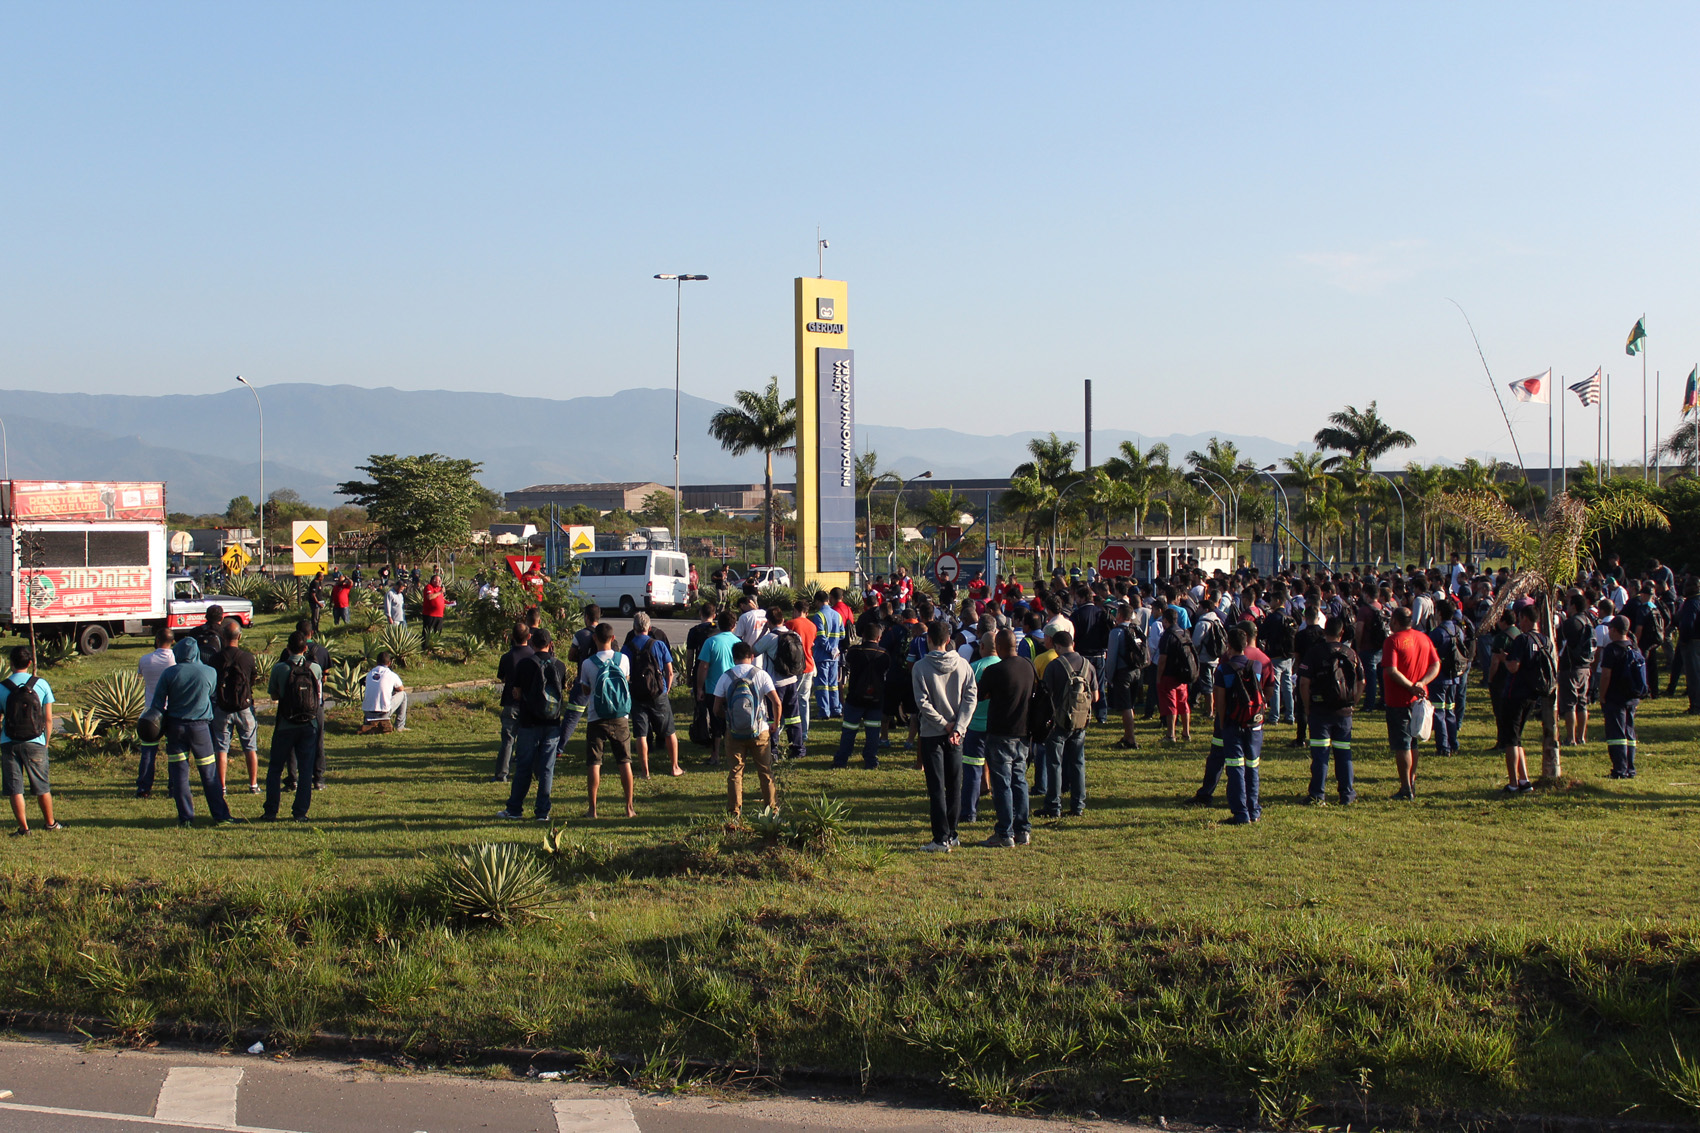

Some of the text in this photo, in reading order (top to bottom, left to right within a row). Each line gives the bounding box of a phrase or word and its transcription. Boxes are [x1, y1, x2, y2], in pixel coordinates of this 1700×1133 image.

[807, 322, 844, 334] GERDAU
[833, 360, 842, 392] USINA
[842, 360, 851, 487] PINDAMONHANGABA
[75, 502, 98, 511] LUTA
[1100, 559, 1130, 572] PARE
